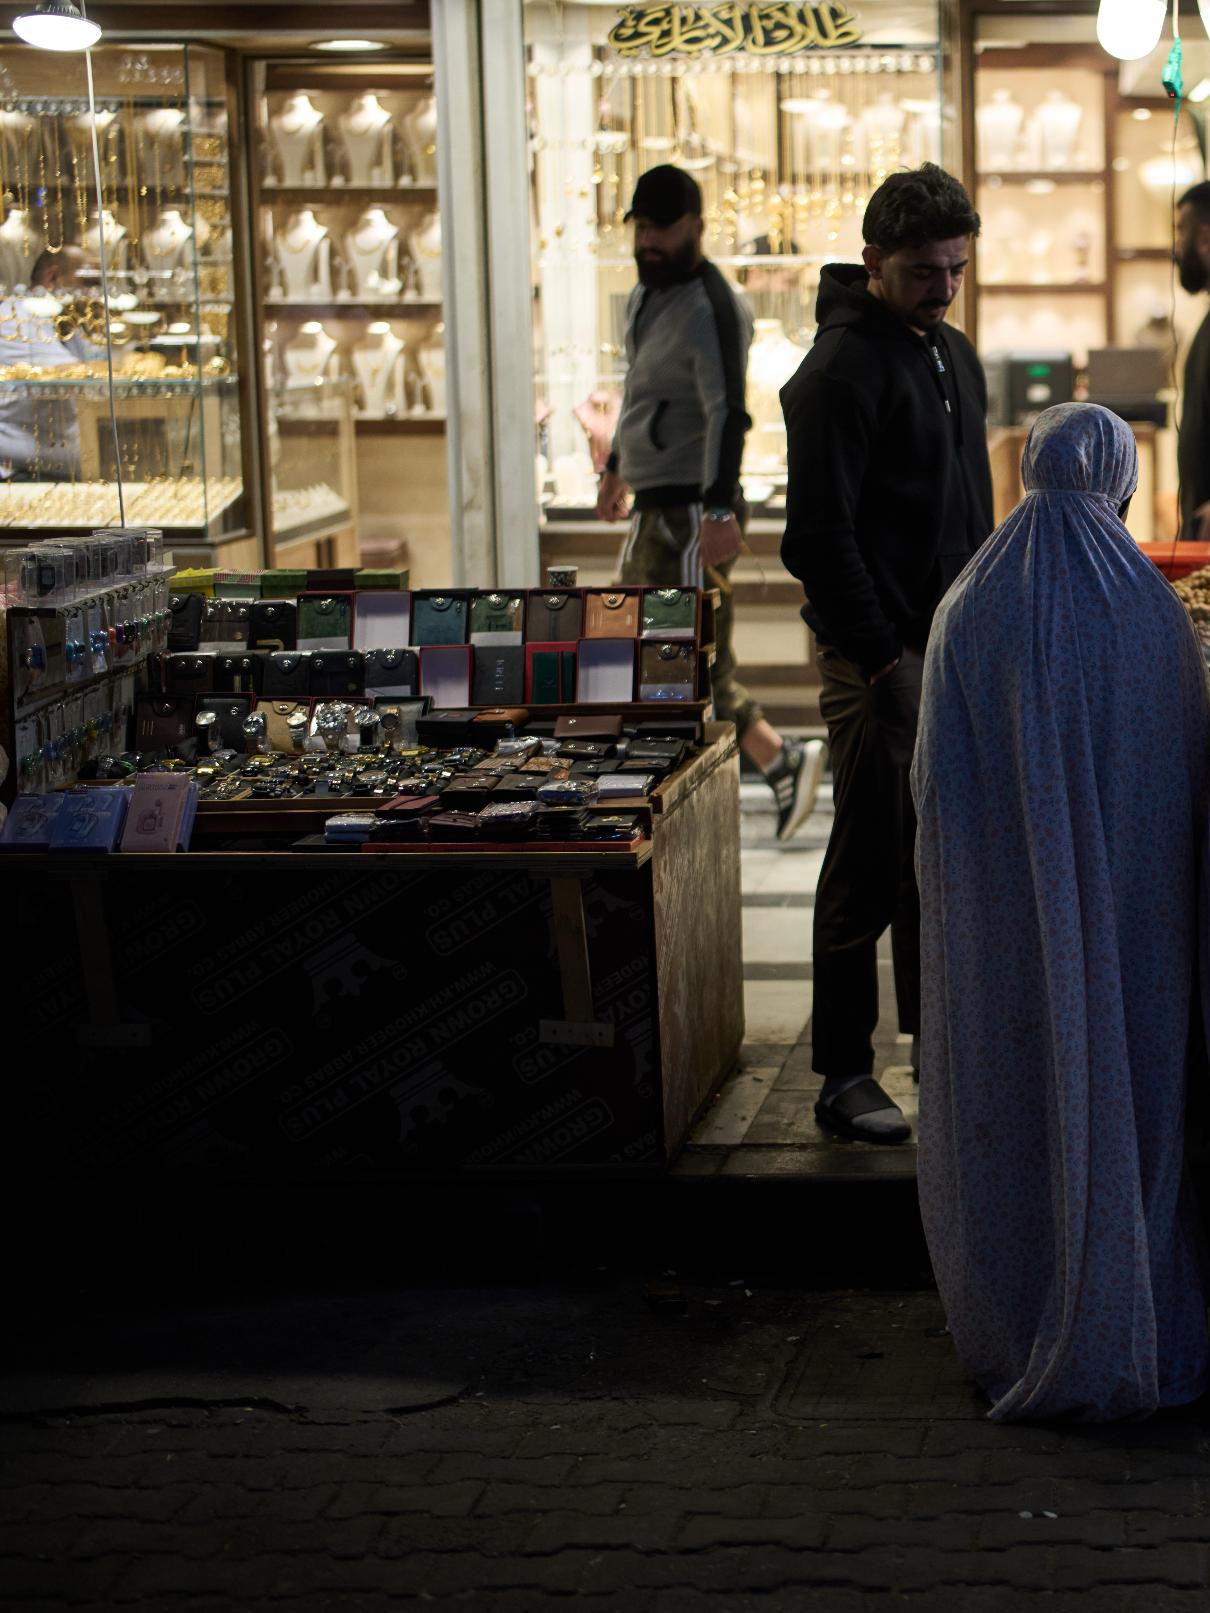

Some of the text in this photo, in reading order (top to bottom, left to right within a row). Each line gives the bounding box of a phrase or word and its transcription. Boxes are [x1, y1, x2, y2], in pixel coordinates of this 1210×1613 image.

[261, 908, 341, 968] ROYAL
[432, 900, 497, 950] PLUS
[197, 959, 262, 1009] PLUS
[348, 1036, 426, 1094] ROYAL
[286, 1085, 350, 1135] PLUS
